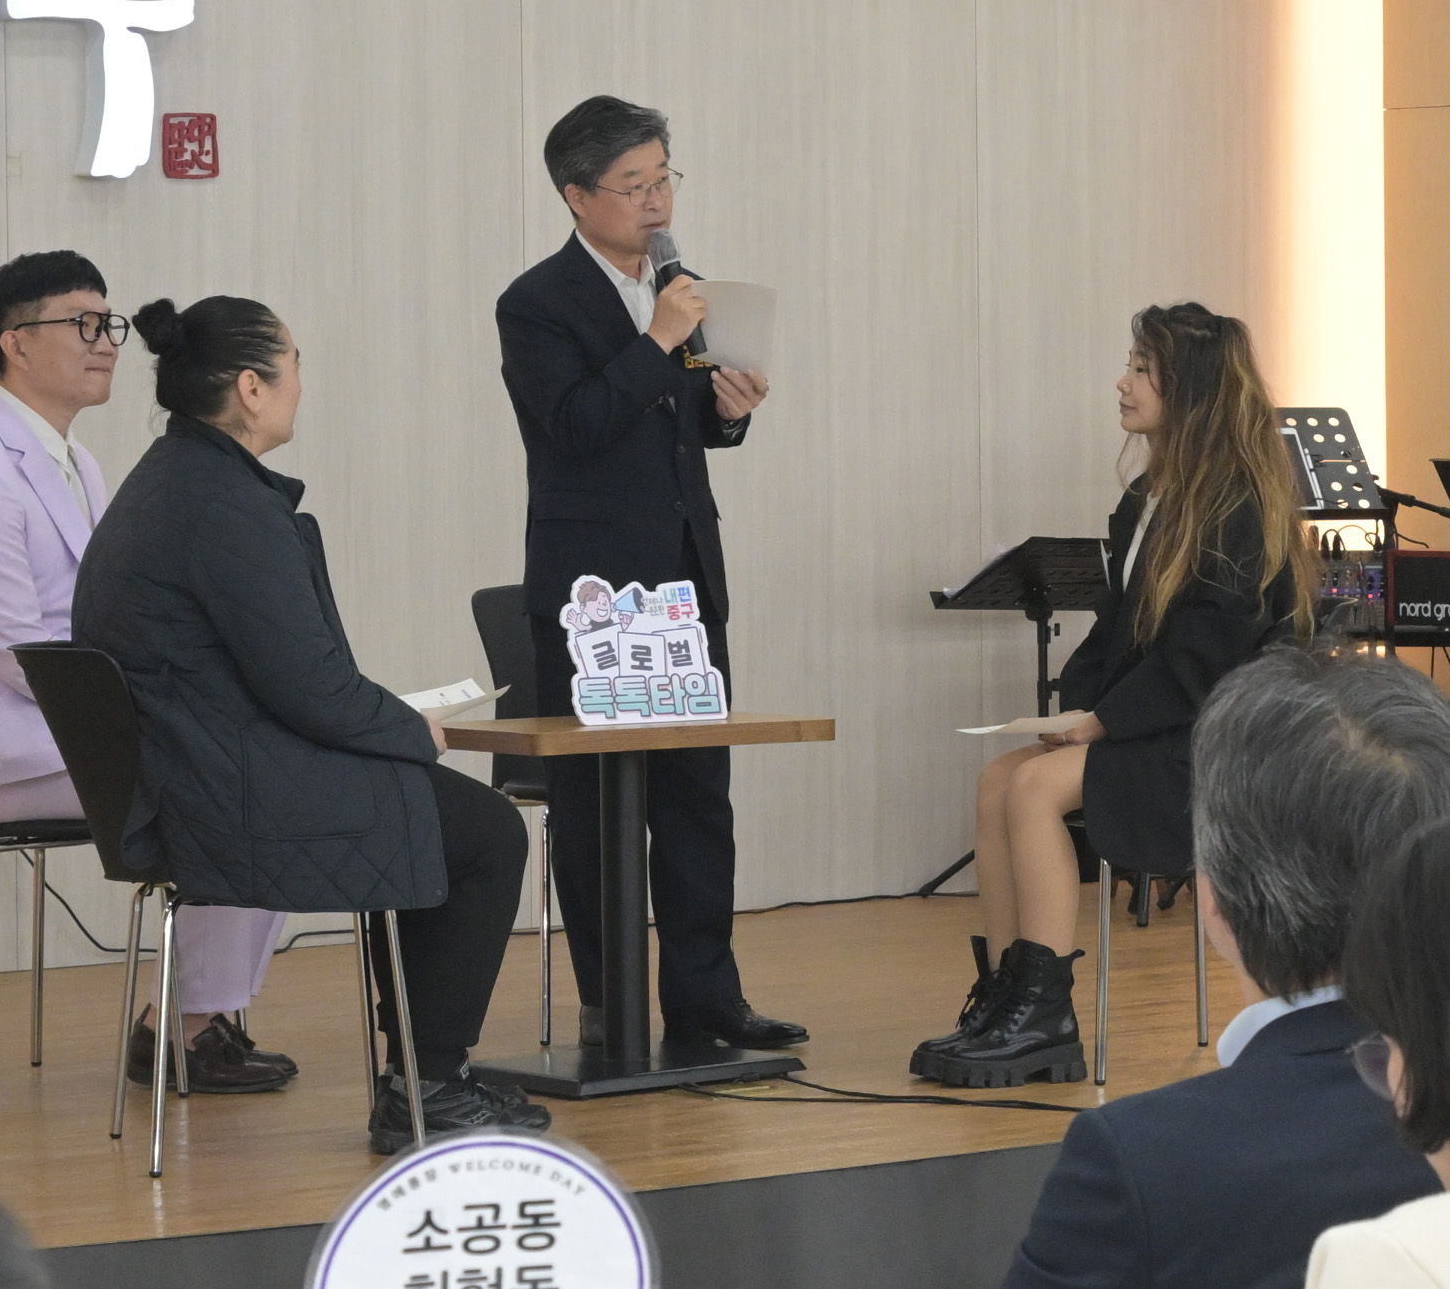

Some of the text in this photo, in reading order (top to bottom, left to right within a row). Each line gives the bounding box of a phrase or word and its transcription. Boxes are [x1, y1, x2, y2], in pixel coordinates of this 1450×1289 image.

[667, 603, 695, 621] 중구
[1399, 600, 1432, 618] nord
[591, 640, 693, 671] 글로벌
[549, 1169, 586, 1196] DAY
[402, 1199, 562, 1255] 소공동
